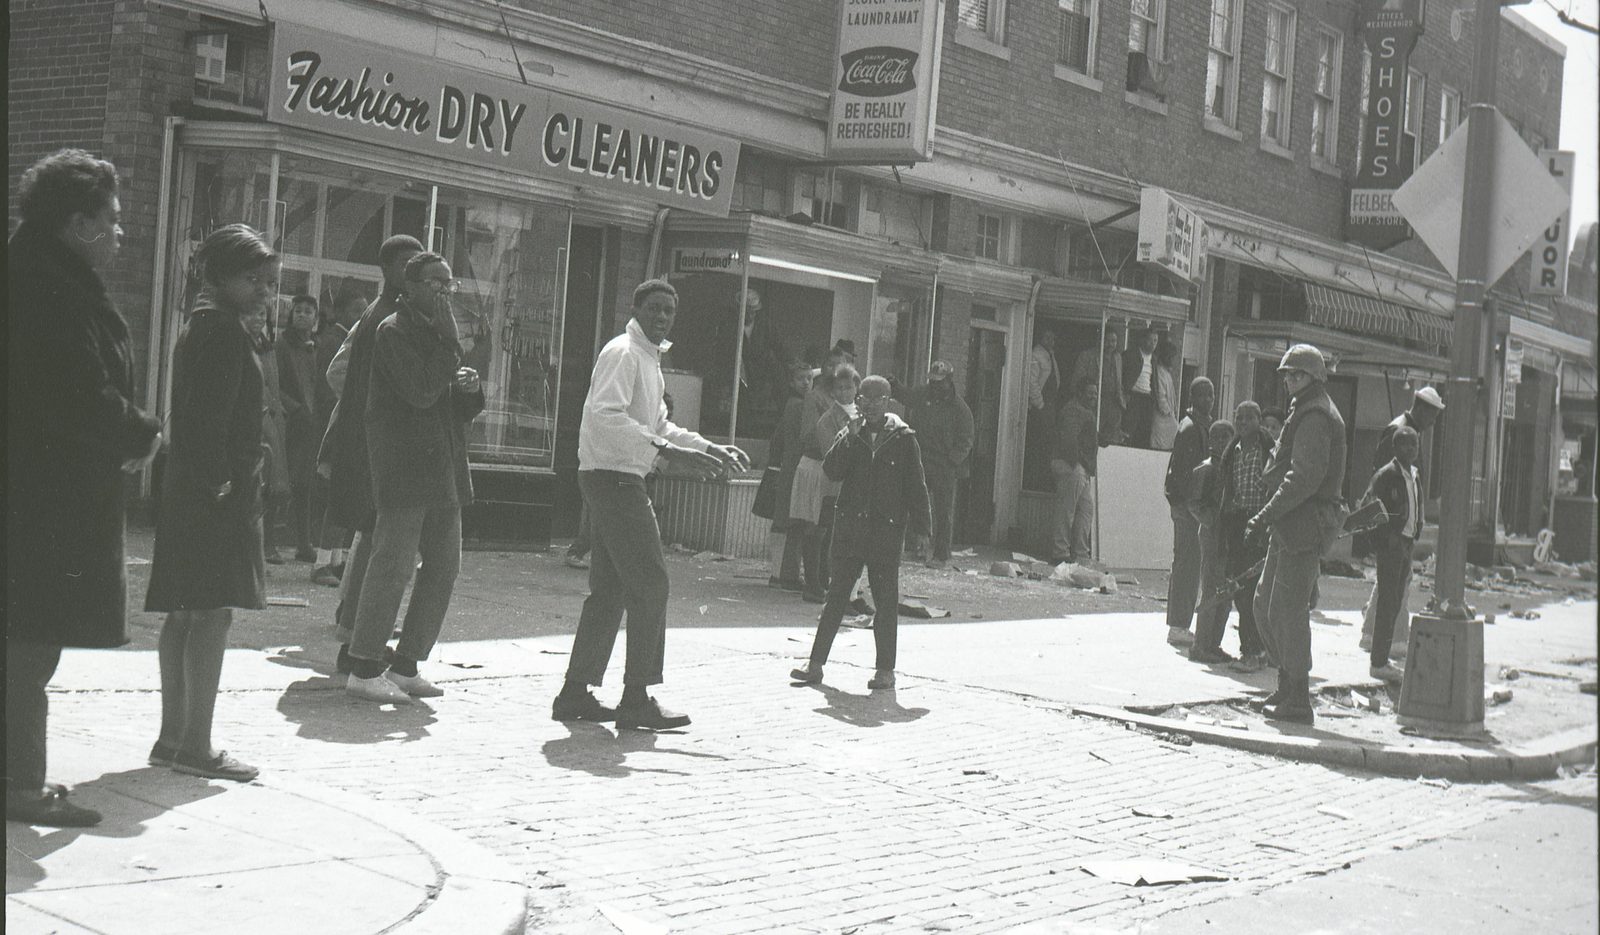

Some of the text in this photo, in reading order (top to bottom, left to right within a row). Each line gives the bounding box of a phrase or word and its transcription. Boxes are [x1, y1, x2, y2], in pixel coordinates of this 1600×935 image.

[847, 10, 919, 26] LAUNDRAMAT
[846, 58, 909, 84] Coca-Cola
[845, 102, 906, 119] BE REALLY
[1372, 37, 1395, 177] SHOES
[285, 50, 723, 201] Fashion DRY CLEANERS
[837, 122, 911, 139] REFRESHED!
[1376, 215, 1404, 226] STORE
[1541, 157, 1564, 288] LUOR
